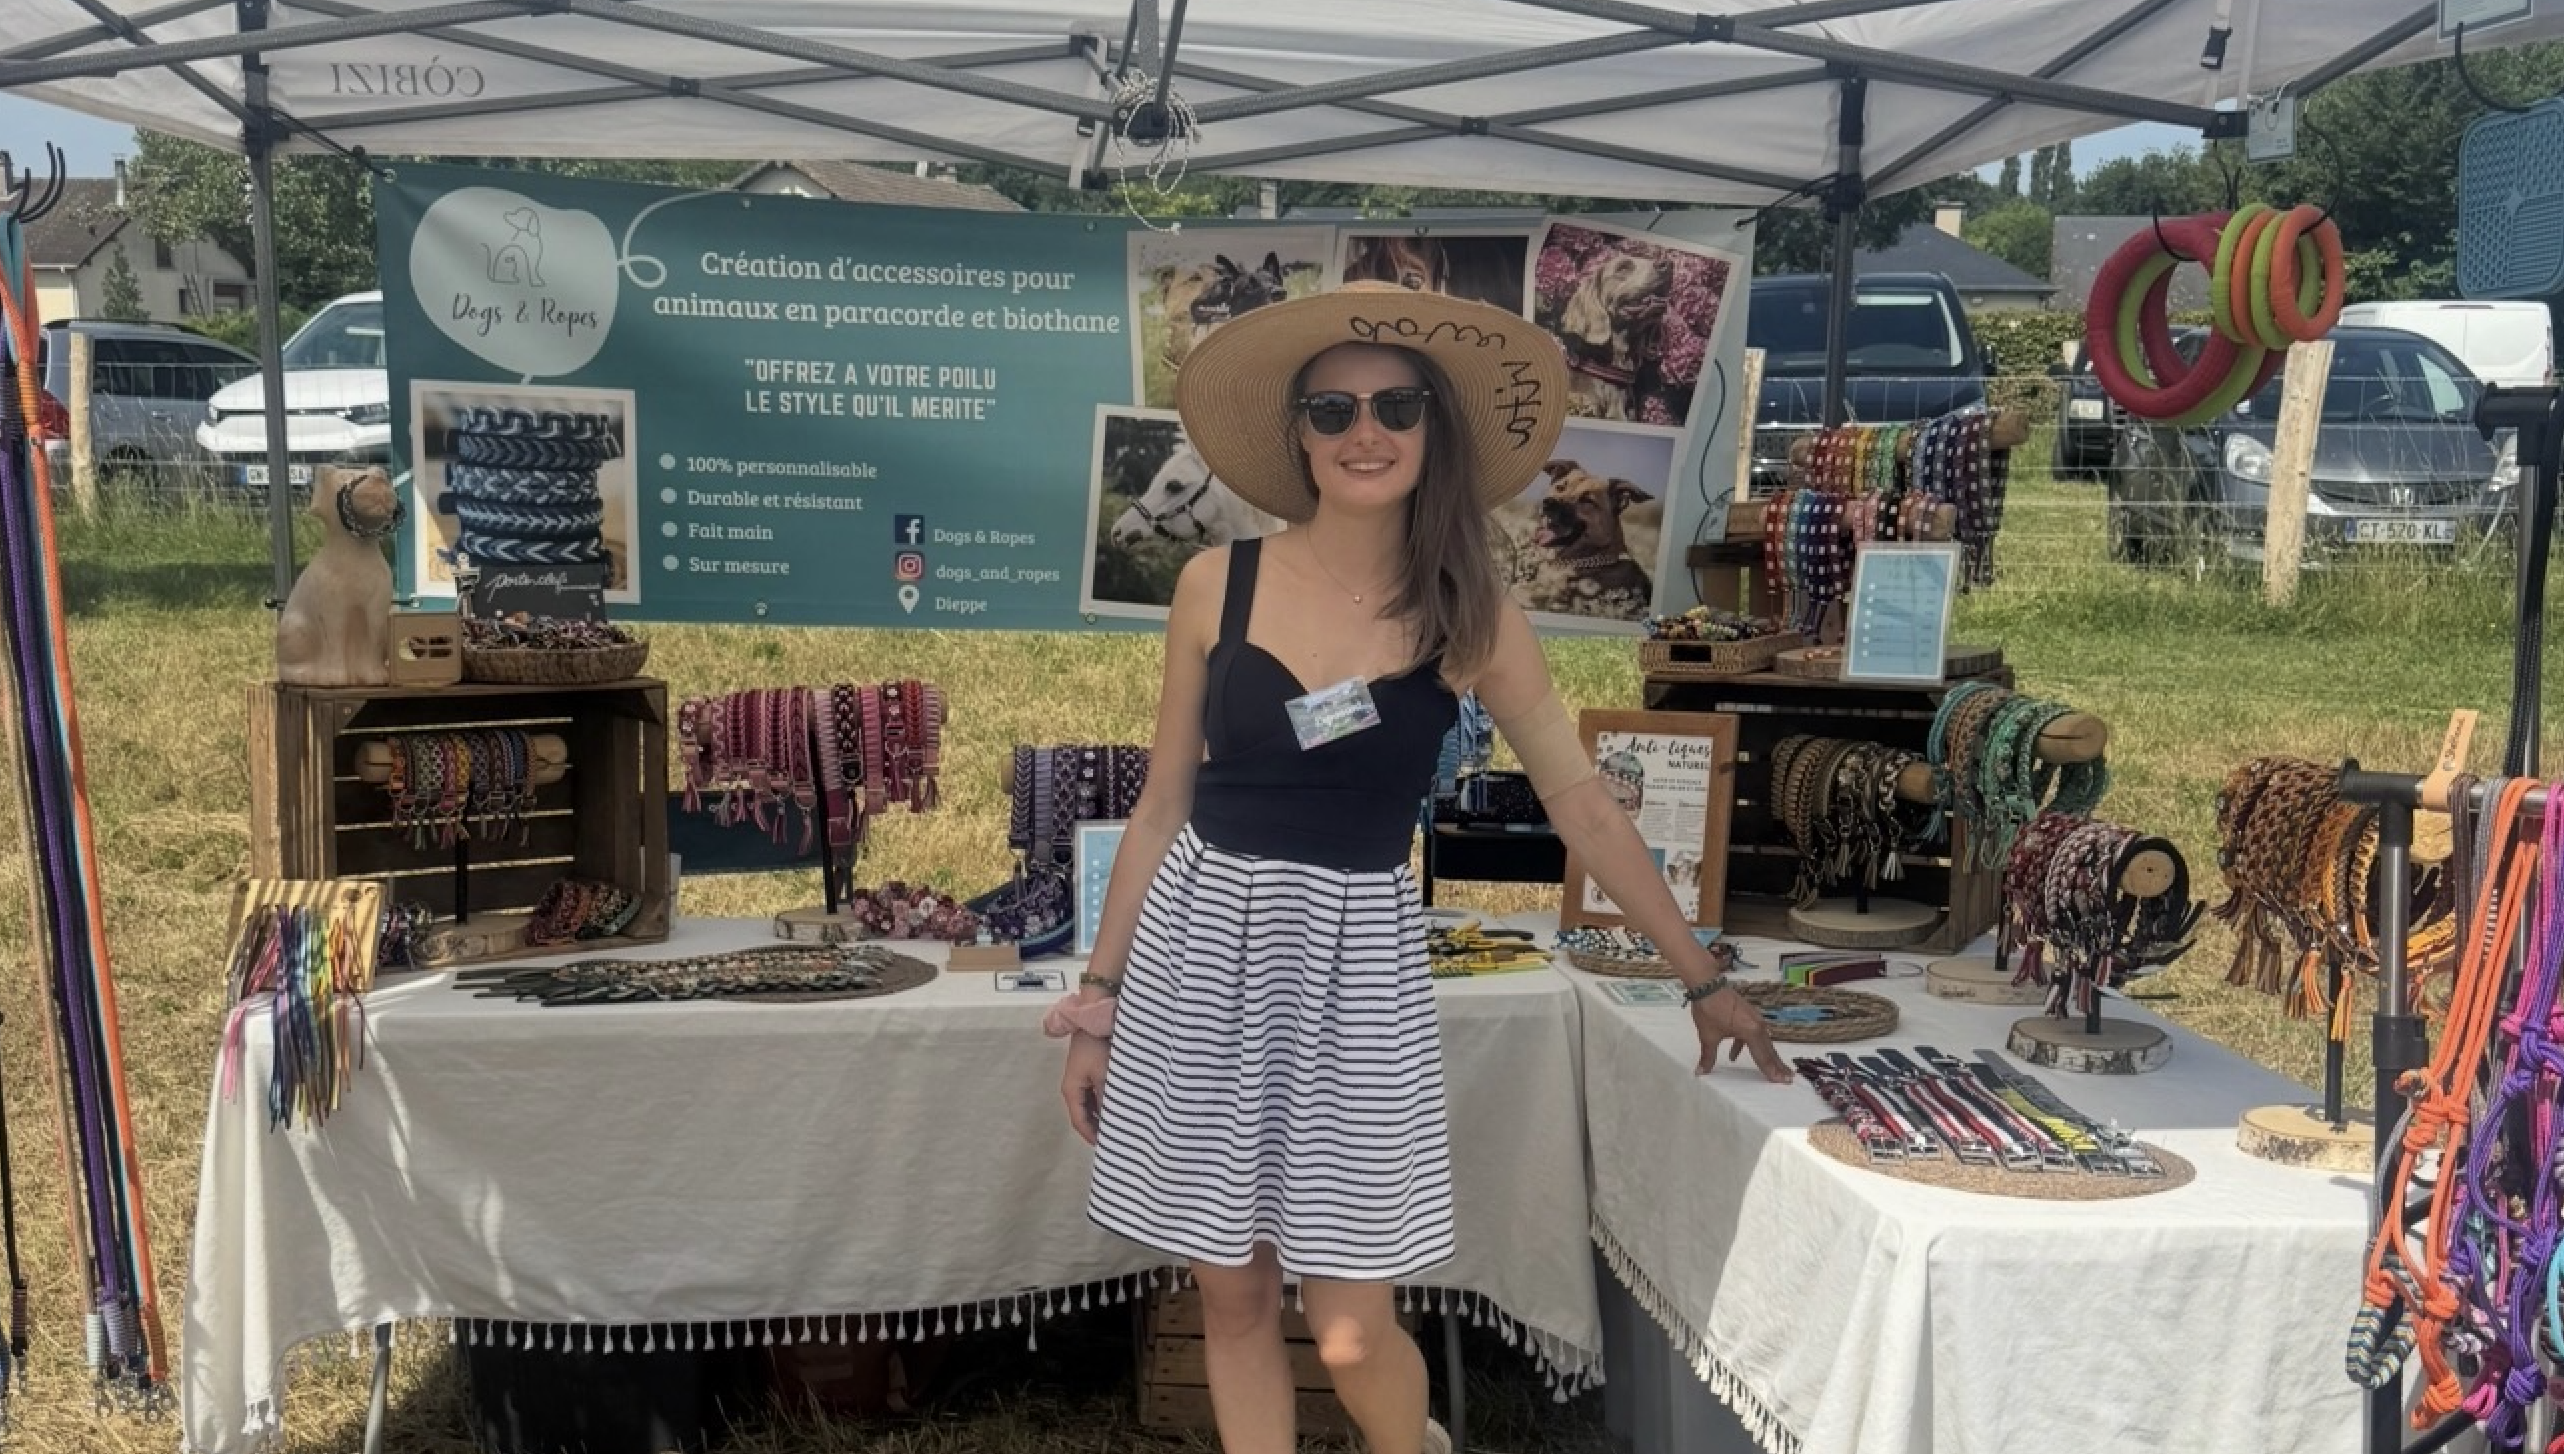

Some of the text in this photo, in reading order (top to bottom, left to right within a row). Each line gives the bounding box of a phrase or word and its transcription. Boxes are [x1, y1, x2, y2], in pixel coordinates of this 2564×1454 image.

[701, 250, 1076, 295] Création d'accessoires pour
[452, 292, 598, 338] Dogs & Ropes
[653, 292, 1120, 334] animaux en paracorde et biothane
[744, 358, 997, 390] "OFFREZ A VOTRE POILU
[744, 390, 997, 420] LE STYLE QU'IL MERITE"
[687, 456, 878, 480] 100% personnalisable
[687, 489, 864, 511] Durable et résistant
[688, 522, 774, 541] Fait main
[934, 528, 1036, 548] Dogs & Ropes
[689, 556, 790, 576] Sur mesure
[936, 564, 1060, 585] dogs_and_ropes
[935, 596, 988, 616] Dieppe
